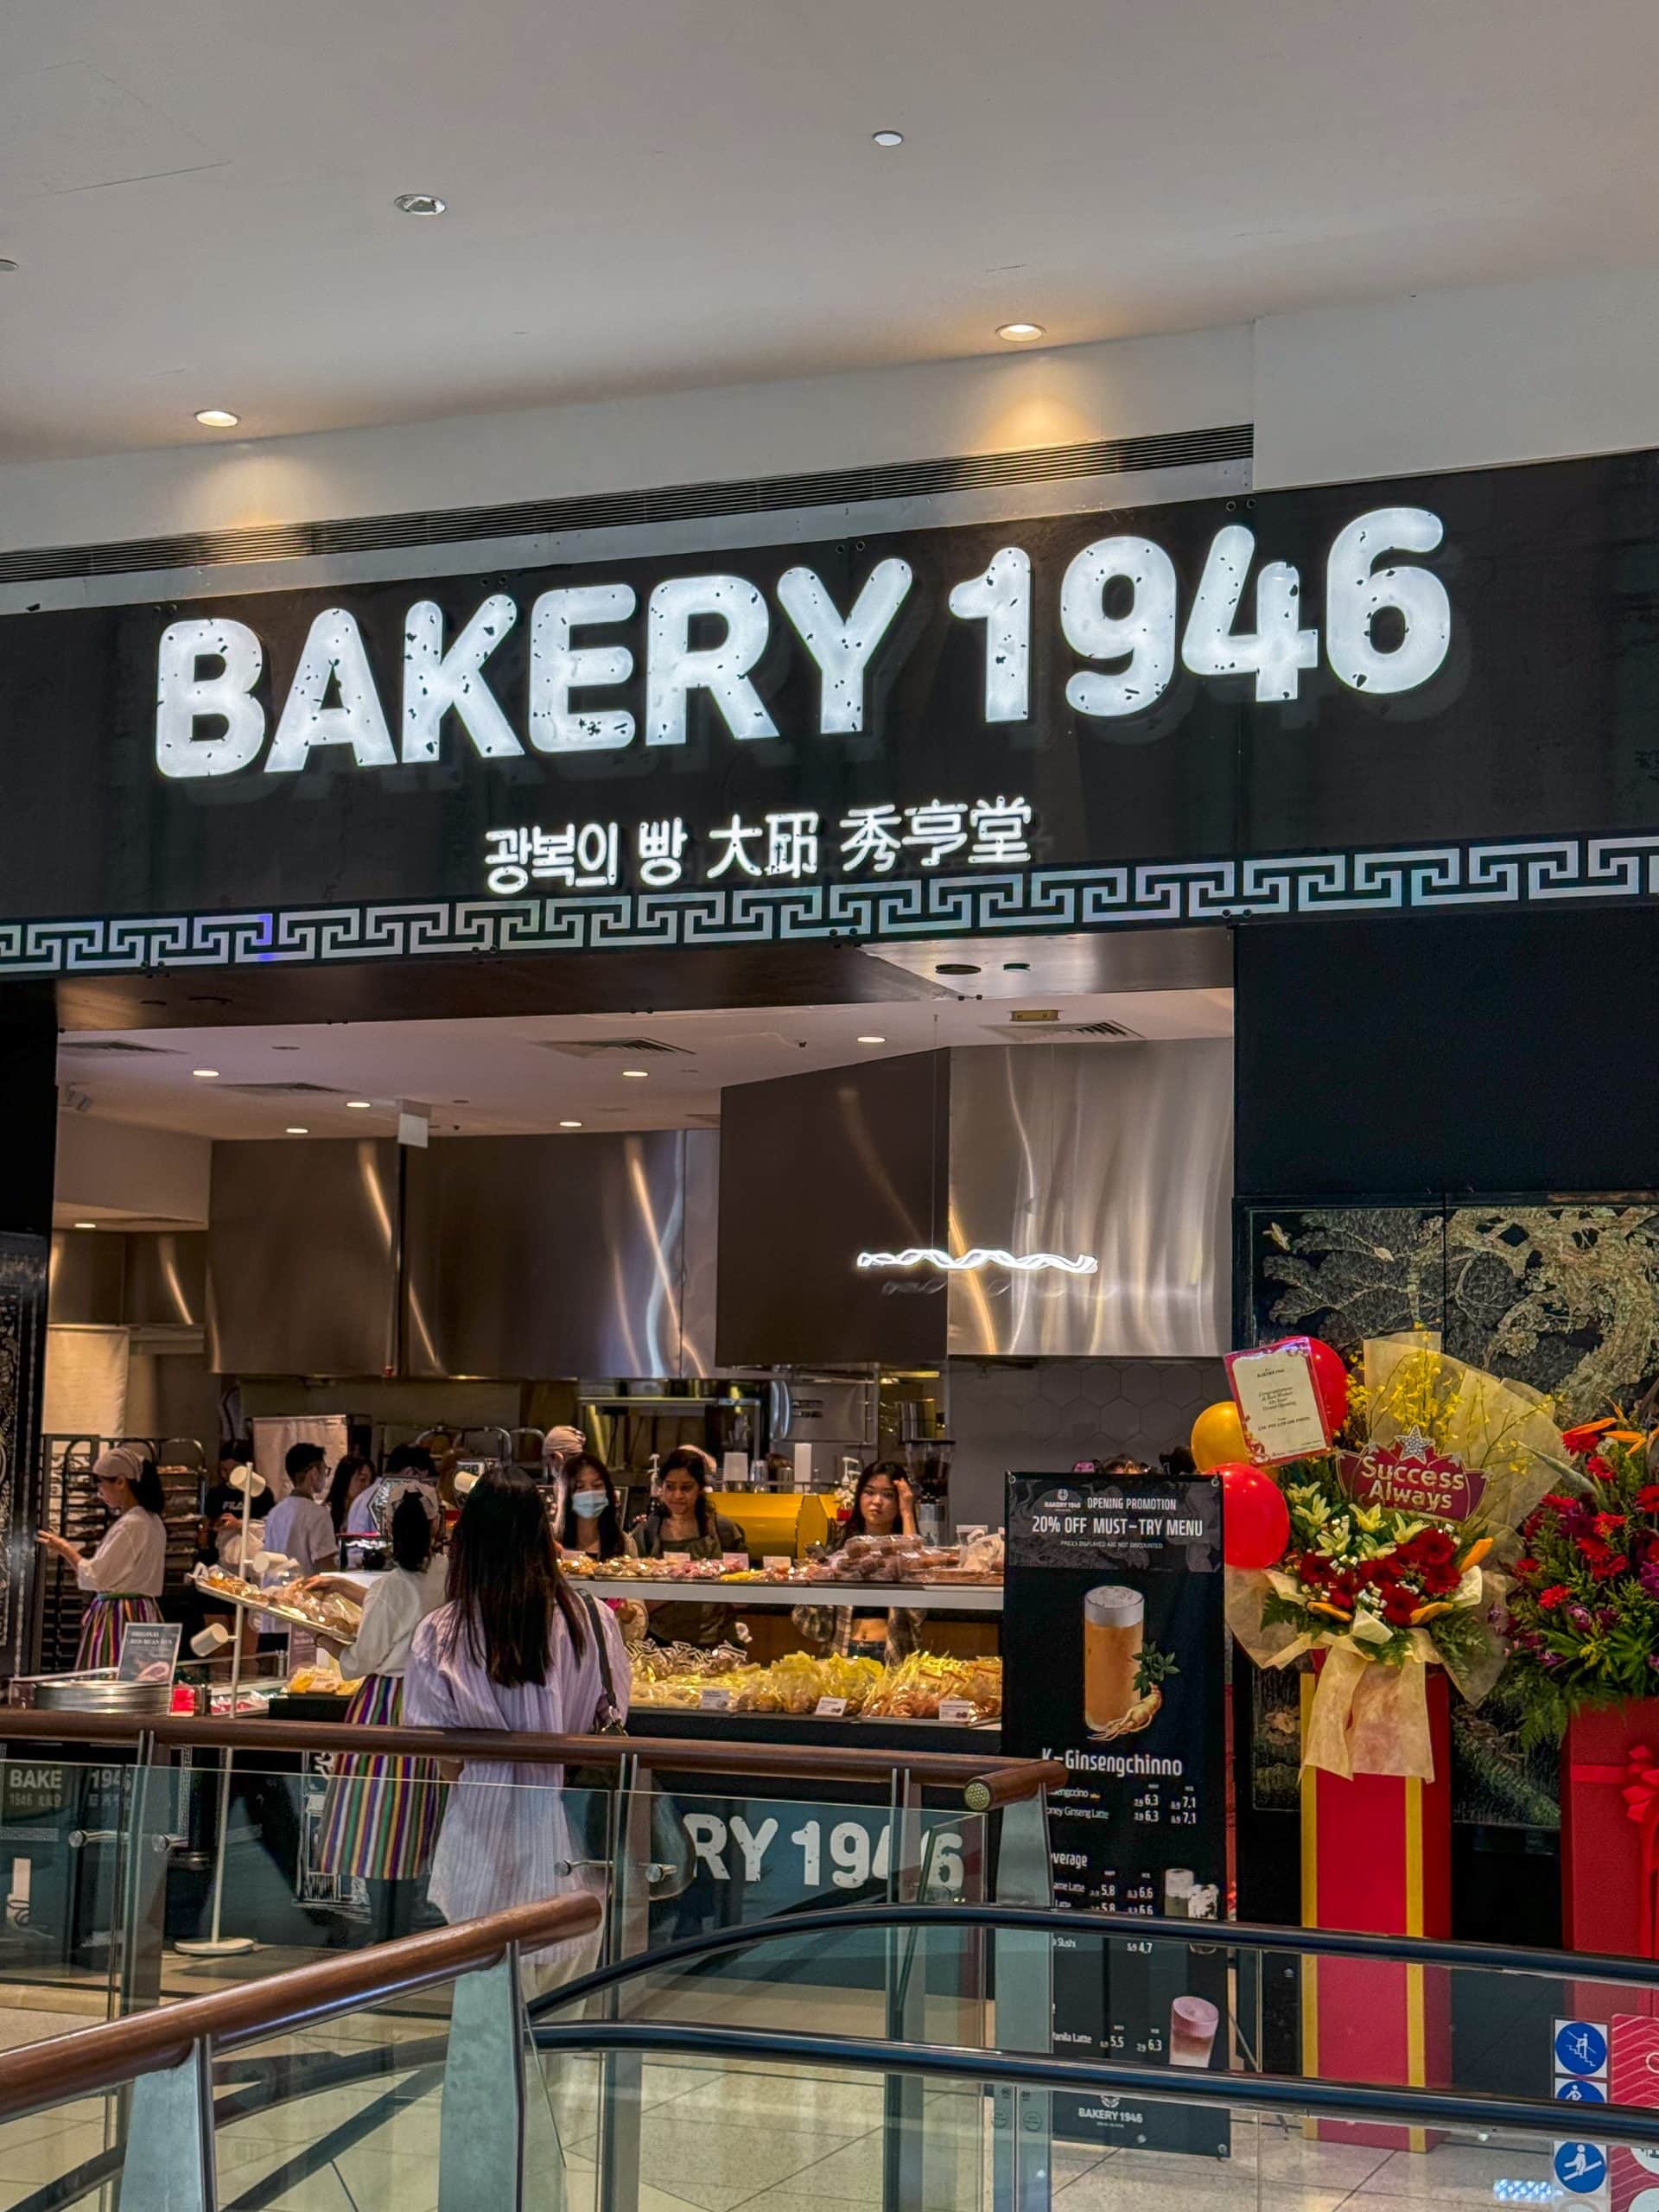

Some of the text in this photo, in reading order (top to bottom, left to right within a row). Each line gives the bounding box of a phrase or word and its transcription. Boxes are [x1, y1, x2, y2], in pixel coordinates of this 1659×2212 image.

[156, 506, 1452, 780] BAKERY 1946
[485, 817, 688, 894] 광복의 빵
[1361, 1455, 1465, 1491] Success
[1087, 1497, 1177, 1510] OPENING PROMOTION
[1369, 1479, 1452, 1512] Always
[1032, 1515, 1061, 1534] 20%
[1065, 1516, 1087, 1534] OFF
[1166, 1519, 1204, 1537] MENU
[10, 1769, 63, 1789] BAKE
[1144, 1794, 1160, 1807] 6.3
[1183, 1796, 1197, 1808] 7.1
[1144, 1810, 1160, 1823] 6.3
[1183, 1812, 1197, 1824] 7.1
[1051, 1852, 1088, 1870] verage
[1101, 1884, 1116, 1897] 5.8
[1139, 1886, 1154, 1899] 6.6
[1139, 1942, 1154, 1954] 4.7
[1110, 2035, 1124, 2048] 5.5
[1148, 2039, 1162, 2052] 6.3
[1078, 2107, 1118, 2121] BAKERY
